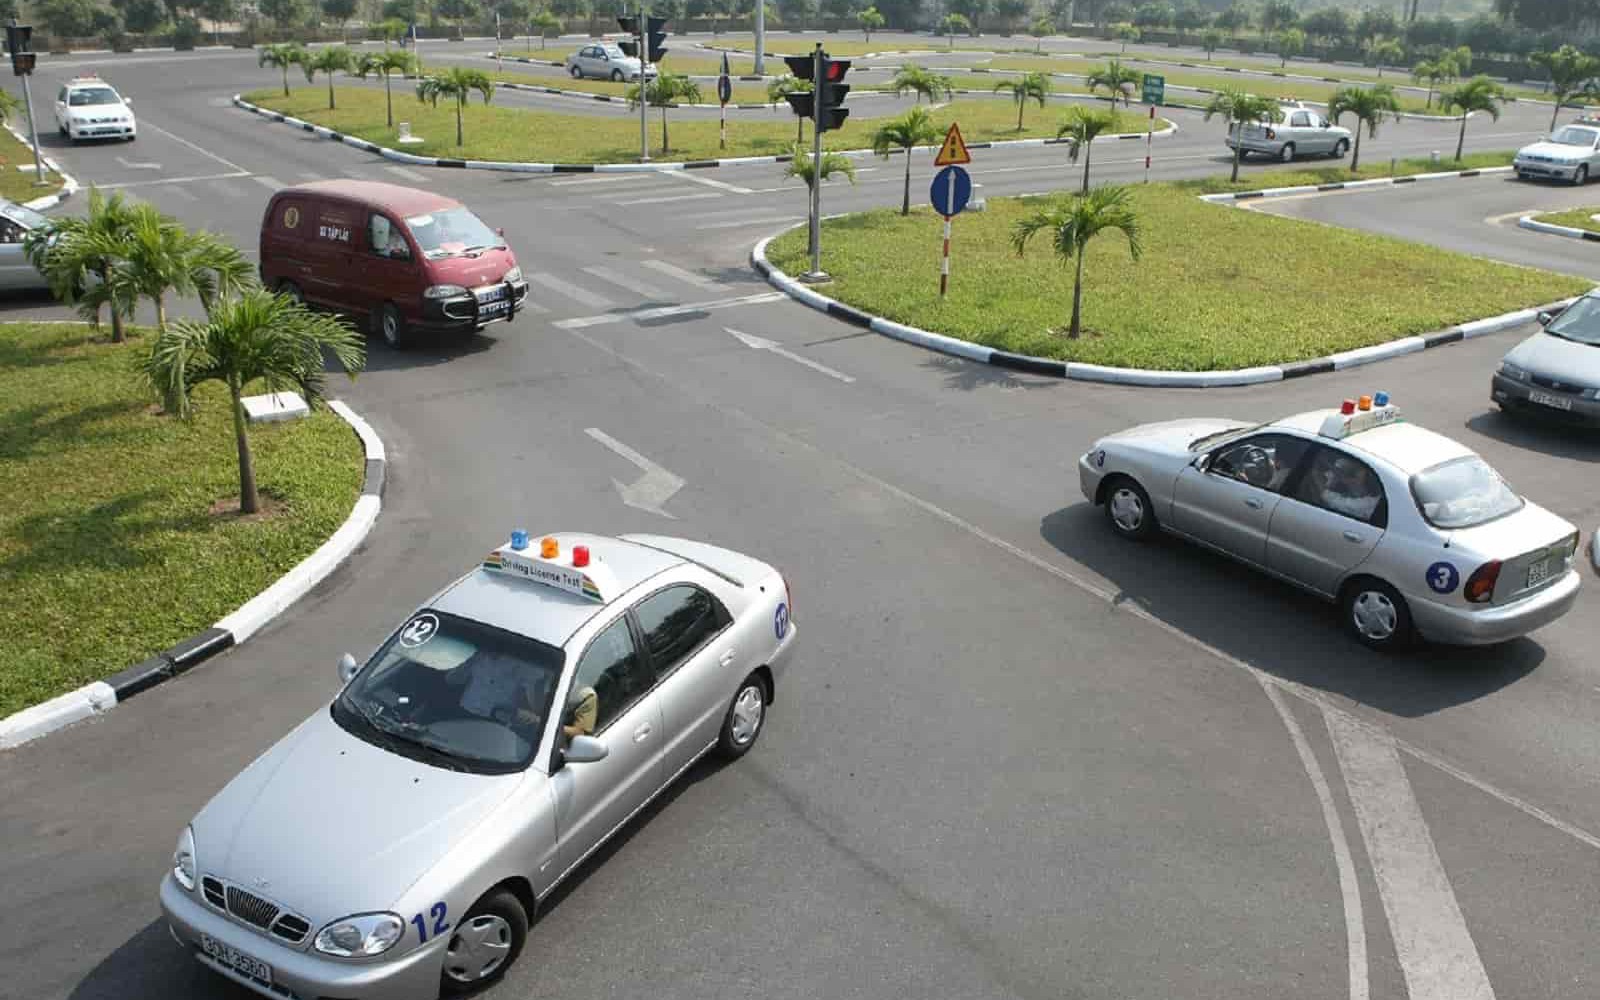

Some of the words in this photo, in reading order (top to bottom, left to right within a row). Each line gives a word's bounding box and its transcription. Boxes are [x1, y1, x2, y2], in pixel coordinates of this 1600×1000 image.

[1097, 450, 1105, 467] 3
[501, 557, 529, 576] Driving
[530, 567, 560, 583] License
[562, 573, 580, 588] Test
[1434, 567, 1450, 589] 3
[403, 620, 433, 642] 12
[411, 901, 449, 943] 12
